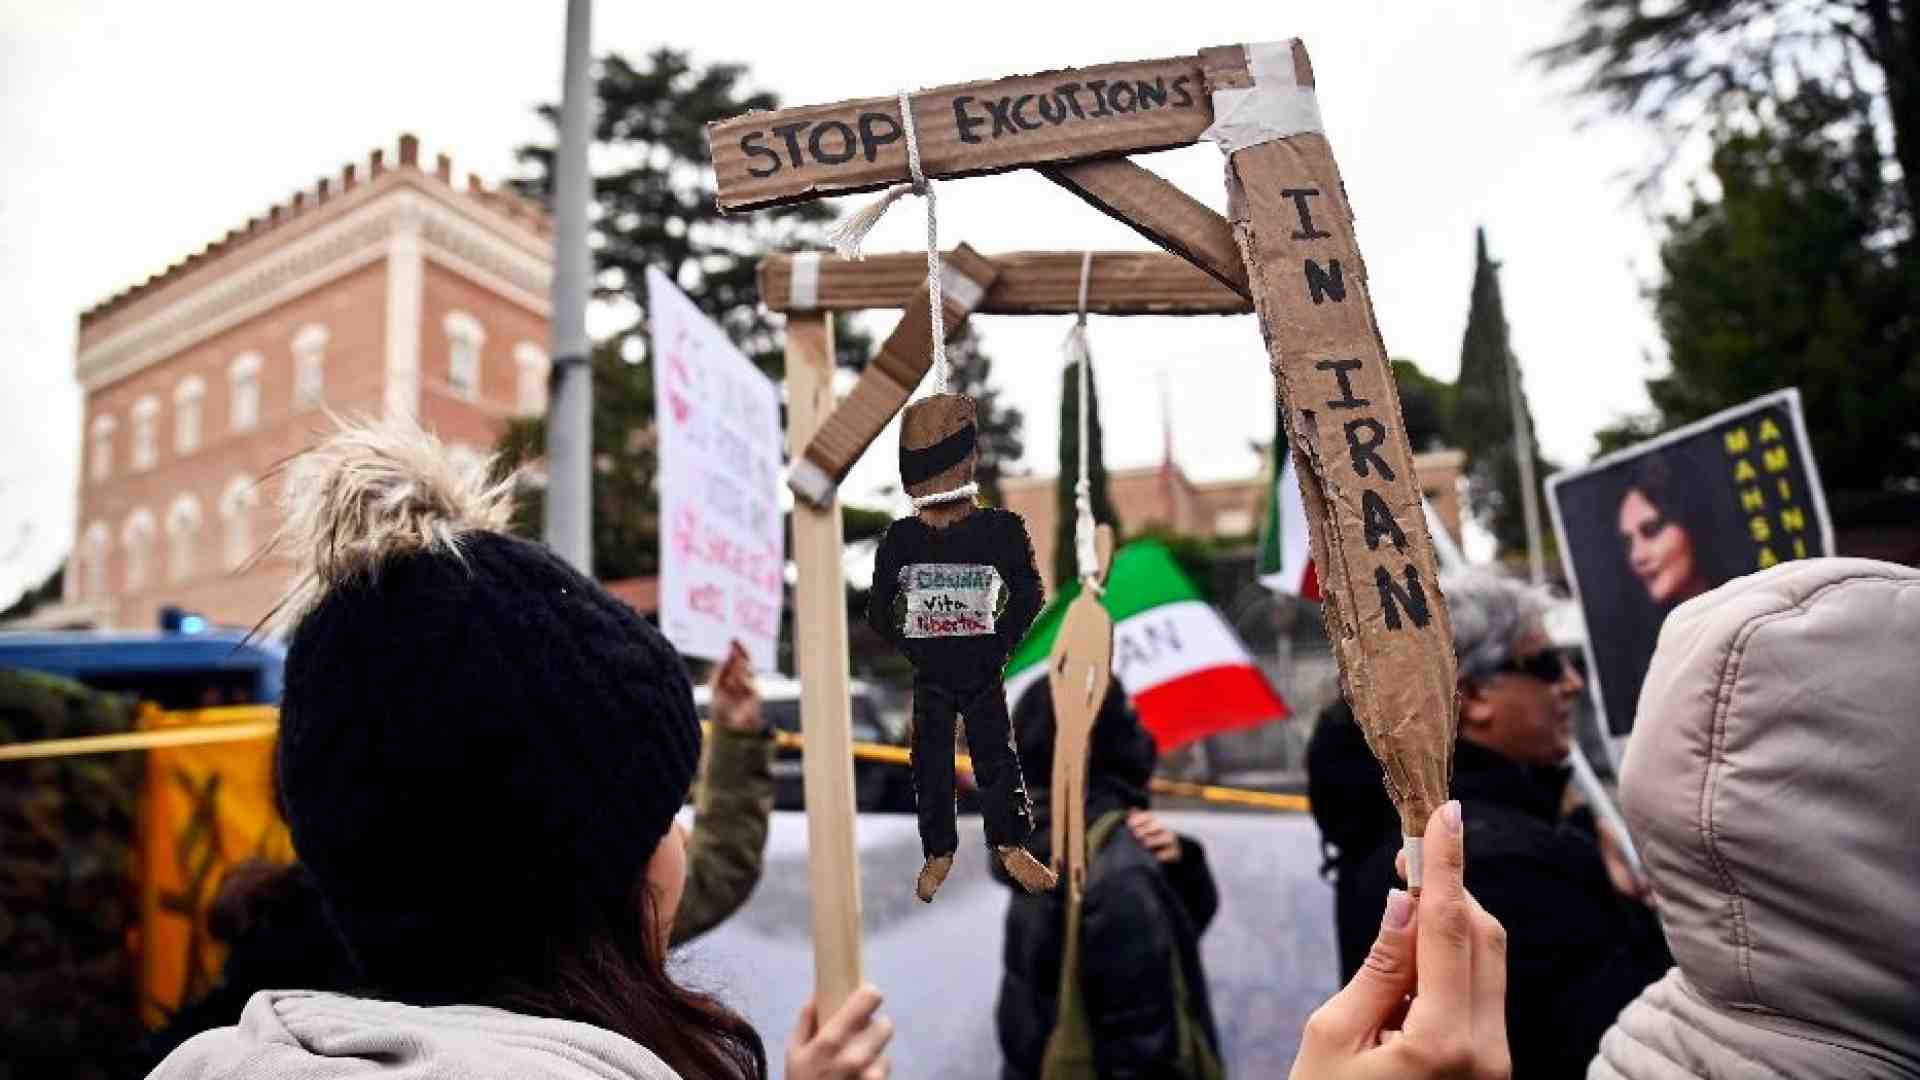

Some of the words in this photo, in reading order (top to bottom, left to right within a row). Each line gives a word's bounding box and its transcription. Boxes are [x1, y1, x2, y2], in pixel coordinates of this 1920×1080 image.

[741, 113, 899, 178] STOP
[953, 75, 1193, 144] EXCUTIONS
[1281, 188, 1346, 305] IN
[1315, 358, 1431, 631] IRAN
[1724, 426, 1778, 568] MAHSA
[1758, 416, 1806, 559] AMINI
[1119, 616, 1182, 670] AN
